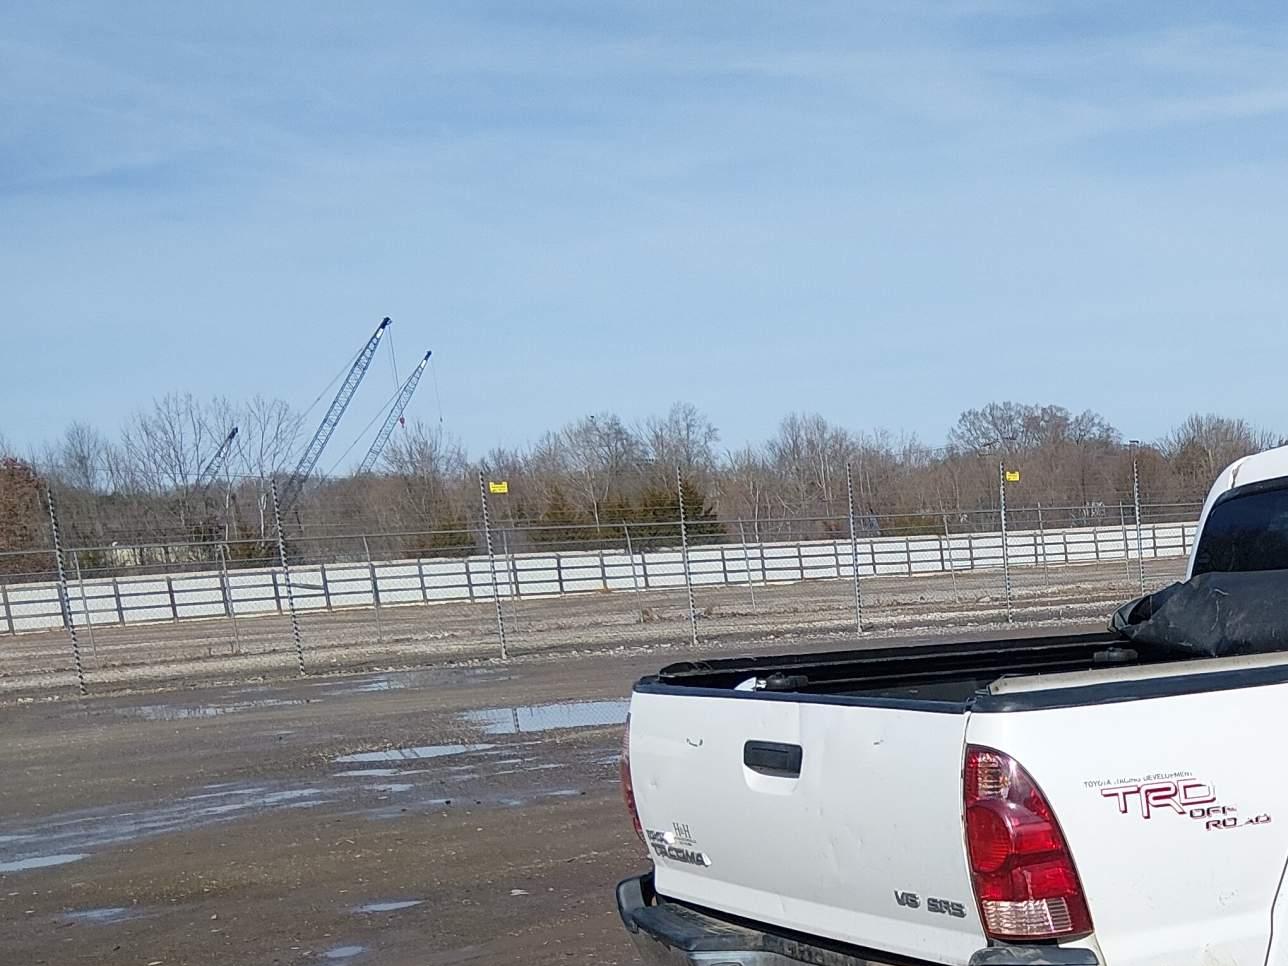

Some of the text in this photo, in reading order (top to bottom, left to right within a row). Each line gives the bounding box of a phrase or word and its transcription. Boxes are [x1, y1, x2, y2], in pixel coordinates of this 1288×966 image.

[1101, 777, 1216, 819] TRD
[651, 842, 712, 868] TACOMA
[894, 890, 920, 909] V6
